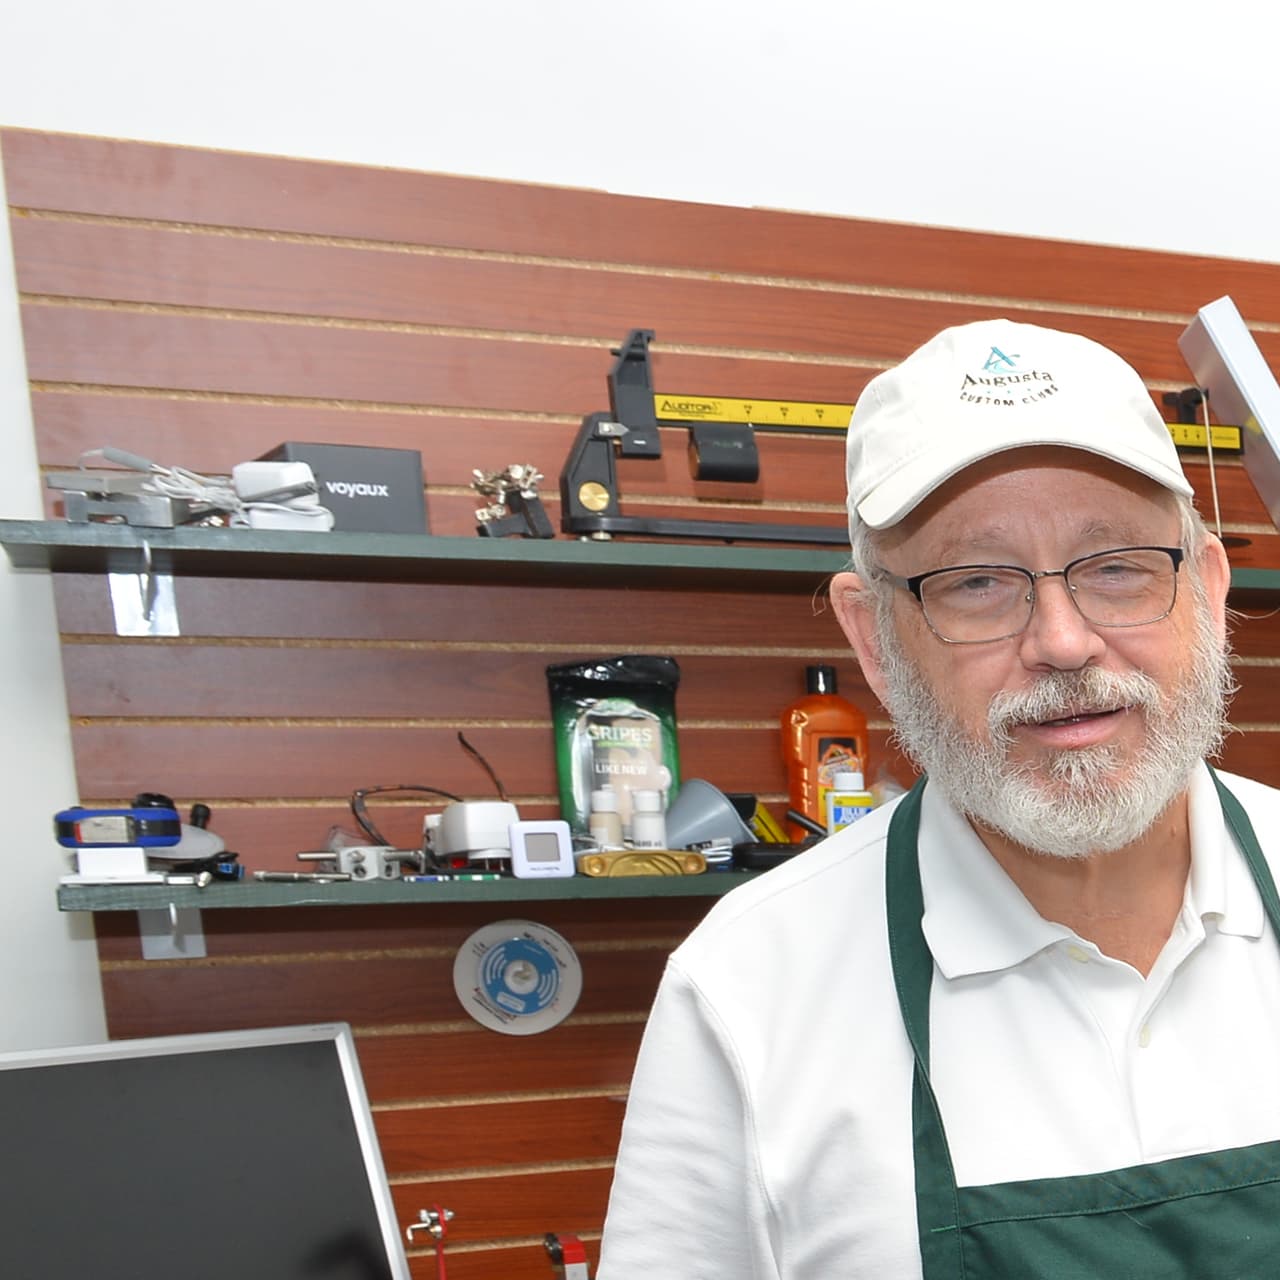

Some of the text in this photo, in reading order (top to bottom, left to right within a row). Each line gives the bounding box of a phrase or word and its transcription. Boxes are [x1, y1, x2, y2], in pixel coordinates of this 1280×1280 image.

[961, 370, 1053, 391] Augusta
[960, 383, 1059, 406] CUSTOM CLUBS
[325, 481, 389, 498] voyaux
